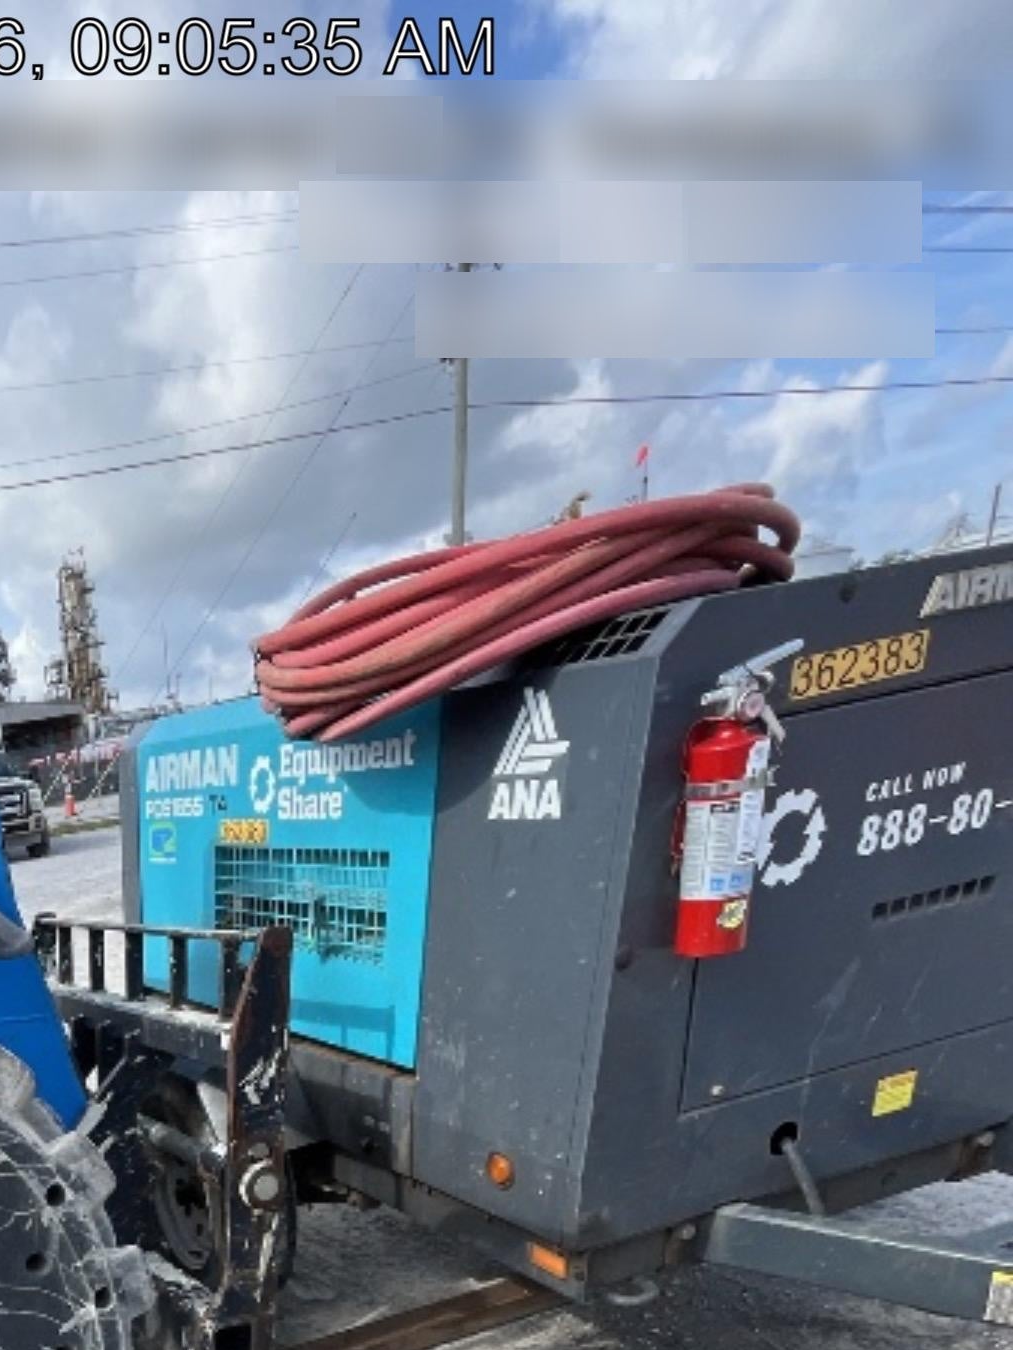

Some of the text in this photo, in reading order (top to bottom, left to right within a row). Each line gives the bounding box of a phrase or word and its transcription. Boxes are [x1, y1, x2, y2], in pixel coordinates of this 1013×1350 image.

[792, 632, 925, 697] 362383
[146, 744, 238, 793] AIRMAN
[278, 728, 416, 785] Equipment
[277, 785, 343, 820] Share
[487, 779, 561, 820] ANA
[866, 761, 967, 802] CALL NOW
